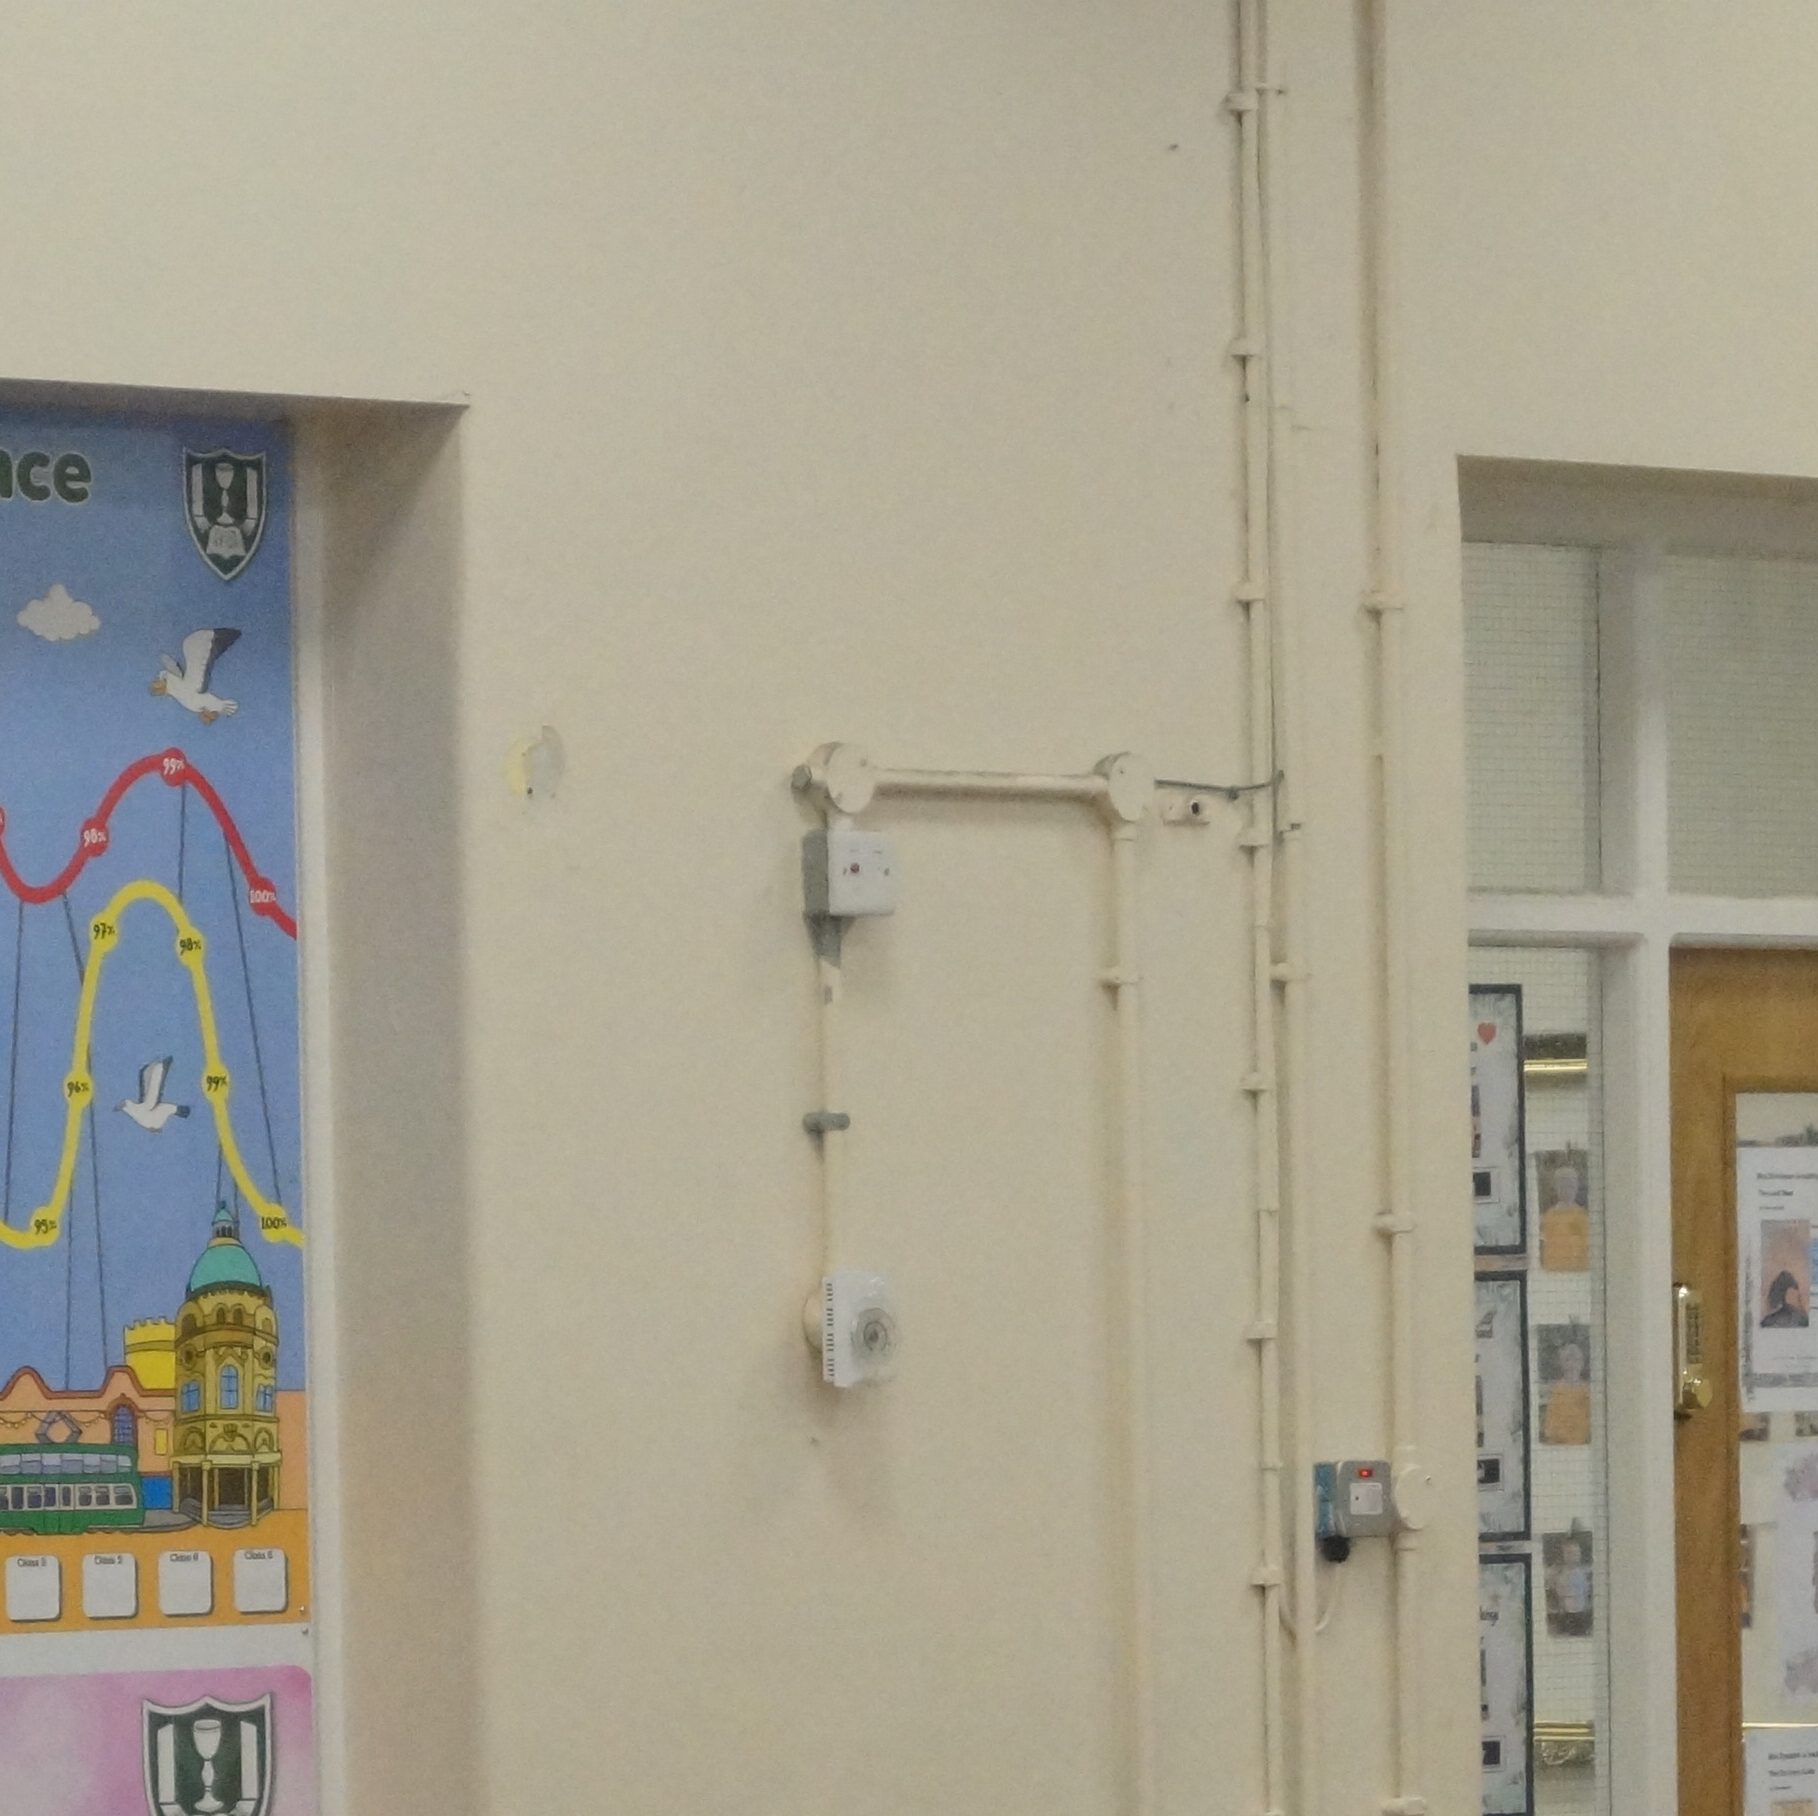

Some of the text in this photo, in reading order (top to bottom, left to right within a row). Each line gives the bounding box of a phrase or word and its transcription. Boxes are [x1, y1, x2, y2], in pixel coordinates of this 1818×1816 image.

[163, 758, 186, 774] 99%
[84, 829, 106, 846] 98%
[250, 889, 277, 903] 100%
[93, 923, 116, 939] 97%
[179, 938, 202, 955] 98%
[67, 1081, 89, 1096] 96%
[206, 1075, 227, 1090] 99%
[34, 1219, 57, 1233] 95%
[261, 1216, 287, 1230] 100%
